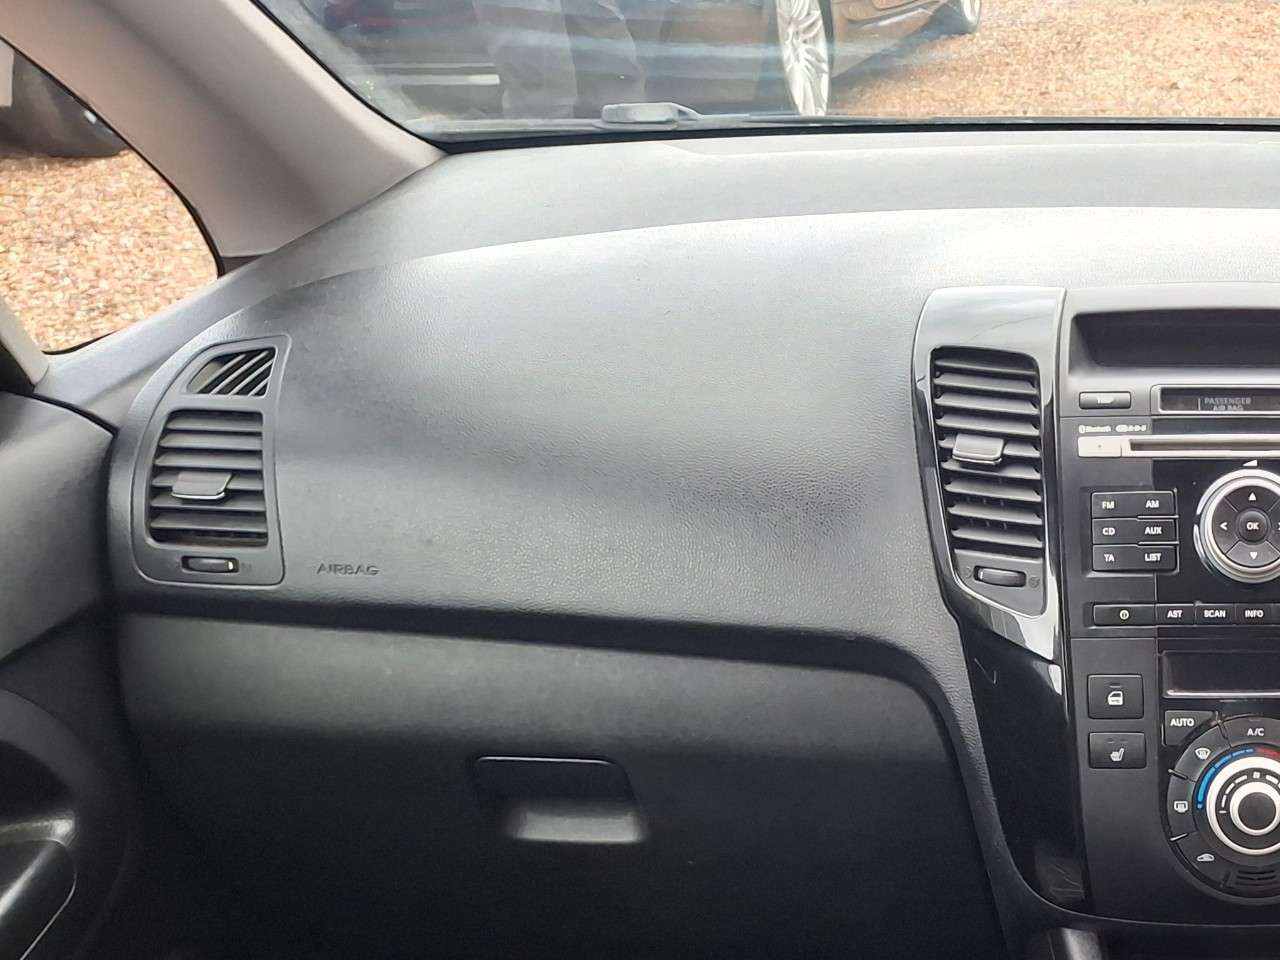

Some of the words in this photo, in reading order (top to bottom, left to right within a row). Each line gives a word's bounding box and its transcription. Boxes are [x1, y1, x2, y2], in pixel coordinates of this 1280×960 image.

[1204, 397, 1251, 405] PASSENGER
[1102, 501, 1115, 509] FM
[1145, 500, 1160, 509] AM
[1144, 526, 1162, 535] AUX
[1246, 521, 1259, 531] OK
[1102, 527, 1116, 536] CD
[1103, 553, 1115, 562] TA
[1144, 553, 1162, 562] LIST
[316, 563, 380, 577] AIRBAG
[1167, 609, 1183, 618] AST
[1203, 609, 1226, 618] SCAN
[1244, 609, 1264, 618] INFO
[1169, 717, 1195, 727] AUTO
[1246, 727, 1265, 737] A/C
